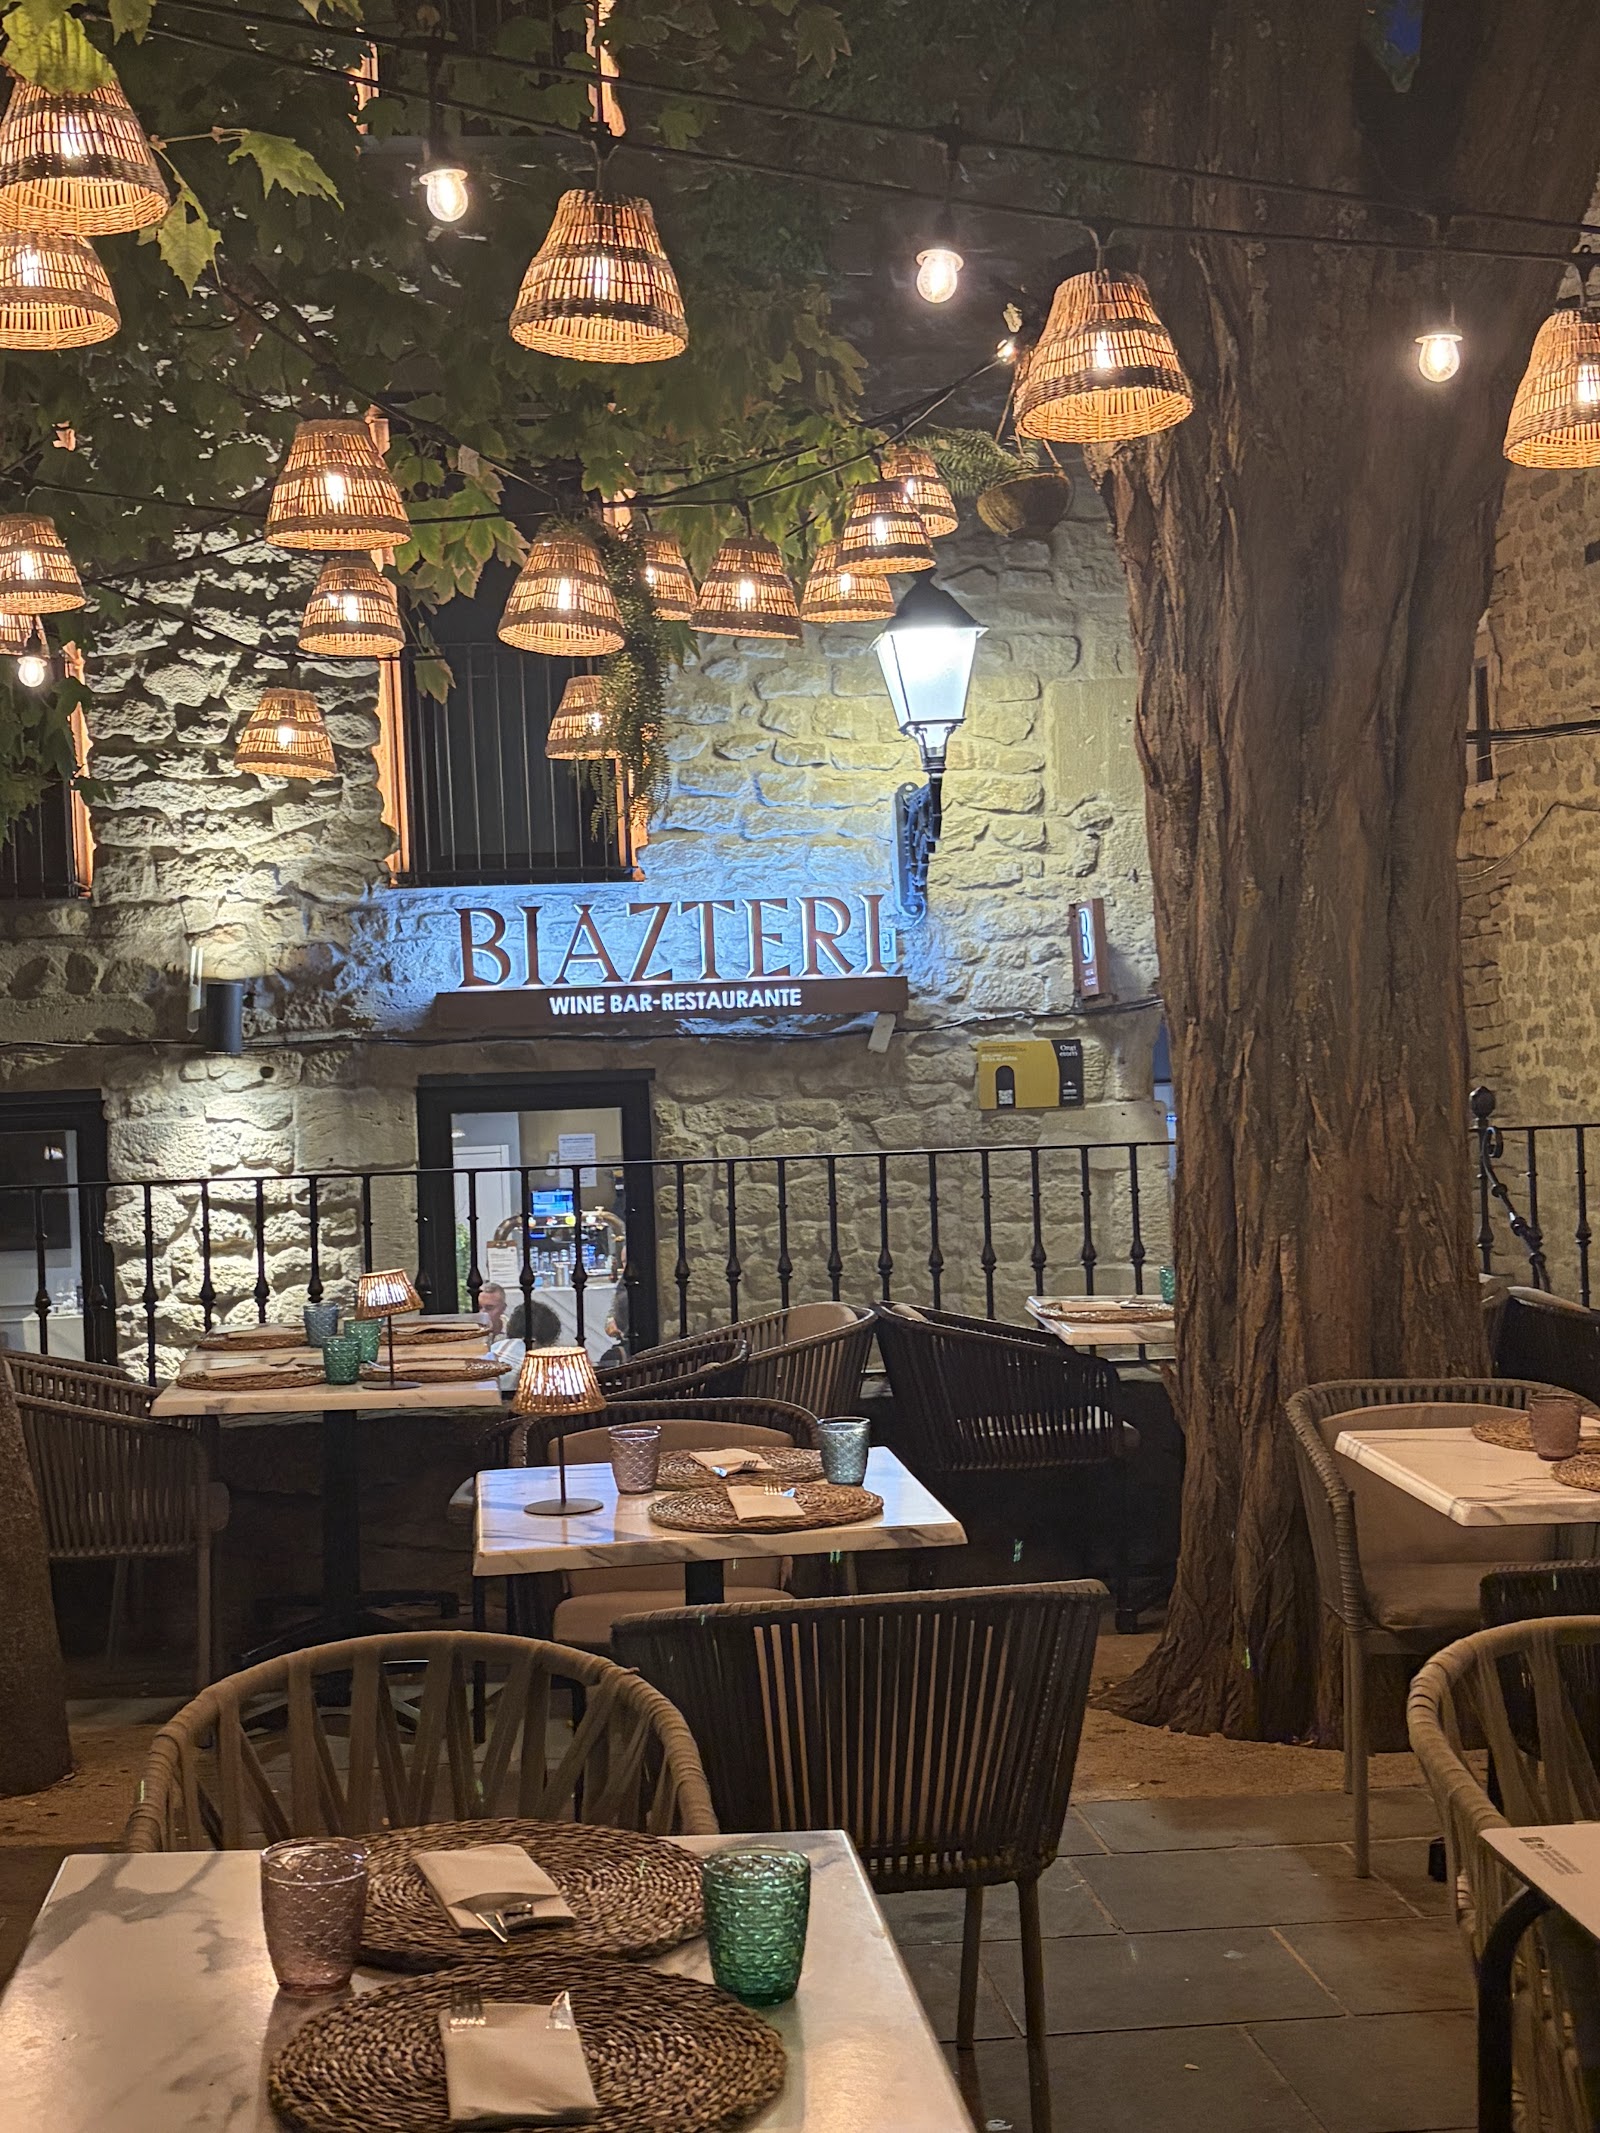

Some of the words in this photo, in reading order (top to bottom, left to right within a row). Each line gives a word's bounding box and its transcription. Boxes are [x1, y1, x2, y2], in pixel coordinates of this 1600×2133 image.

[455, 894, 886, 988] BIAZTERI
[549, 994, 605, 1016] WINE
[609, 988, 803, 1014] BAR-RESTAURANTE
